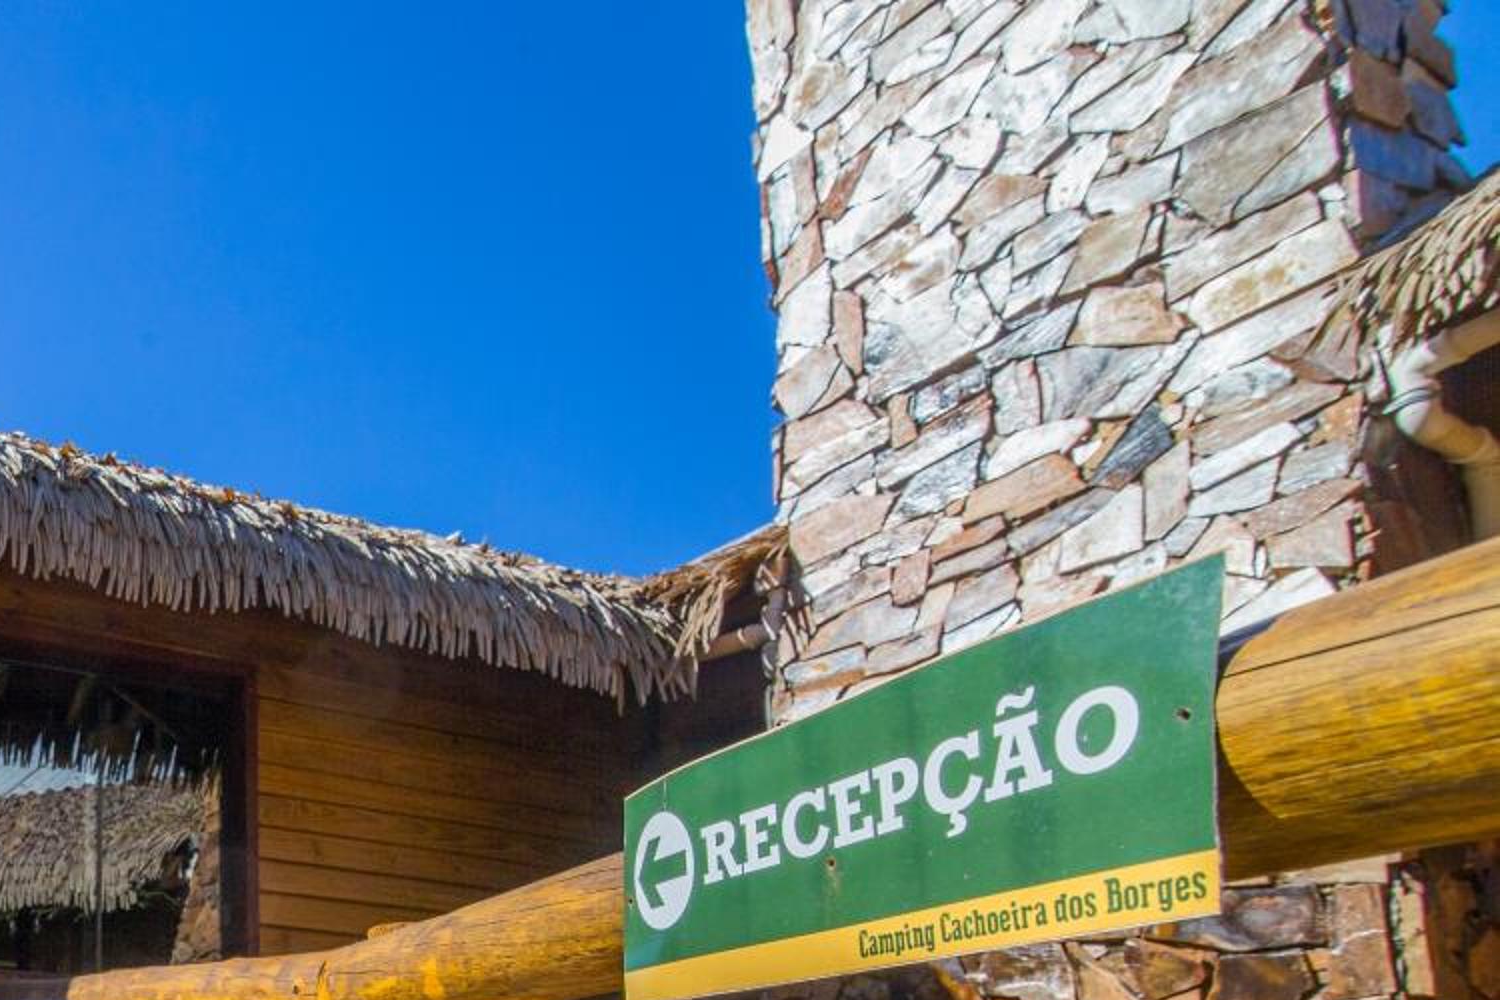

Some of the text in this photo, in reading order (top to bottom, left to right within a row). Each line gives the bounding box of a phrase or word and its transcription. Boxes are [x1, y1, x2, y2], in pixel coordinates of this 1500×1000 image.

[700, 685, 1140, 885] RECEPÇÃO
[859, 871, 1207, 958] Camping Cachoeira dos Borges
